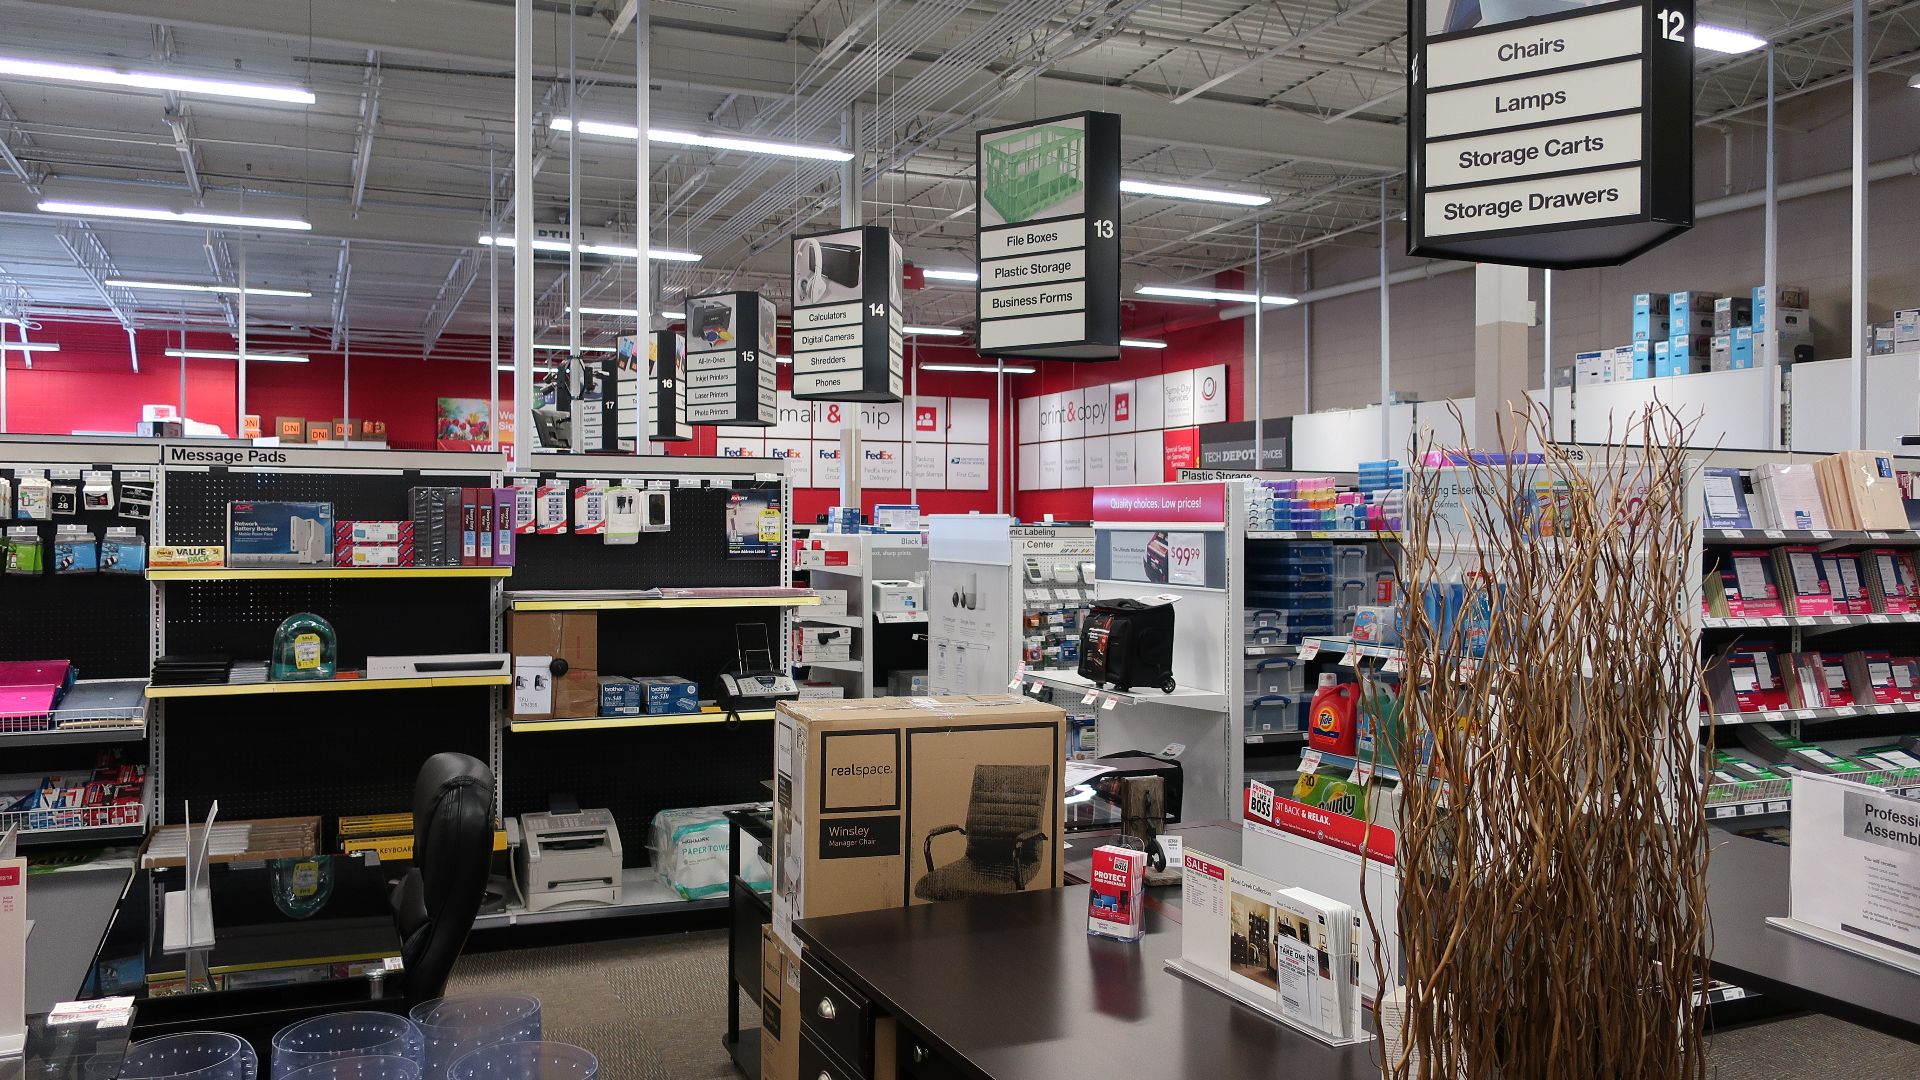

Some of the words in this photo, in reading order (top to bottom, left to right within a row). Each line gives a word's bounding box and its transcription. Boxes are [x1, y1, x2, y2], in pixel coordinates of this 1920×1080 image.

[1657, 8, 1685, 43] 12
[1497, 37, 1565, 62] Chairs
[1495, 89, 1567, 114] Lamps
[1458, 143, 1540, 169] Storage
[1544, 135, 1604, 158] Carts
[1443, 195, 1523, 221] Storage
[1528, 186, 1619, 211] Drawers
[1093, 219, 1114, 239] 13
[1006, 234, 1024, 247] File
[1026, 231, 1058, 245] Boxes
[994, 265, 1029, 279] Plastic
[1030, 260, 1072, 275] Storage
[992, 294, 1038, 309] Business
[1039, 291, 1073, 304] Forms
[868, 302, 885, 317] 14
[808, 310, 847, 322] Calculators
[801, 333, 824, 345] Digital
[824, 332, 855, 343] Cameras
[698, 356, 726, 365] All-in-Ones
[741, 350, 755, 362] 15
[810, 354, 846, 366] Shredders
[661, 378, 673, 389] 16
[695, 373, 709, 383] Inkjet
[709, 373, 729, 381] Printers
[815, 377, 841, 387] Phones
[694, 391, 709, 400] Laser
[709, 391, 729, 400] Printers
[605, 400, 615, 410] 17
[694, 409, 709, 417] Photo
[709, 408, 729, 416] Printers
[780, 402, 822, 423] mail
[827, 404, 840, 423] &
[1040, 405, 1066, 431] print
[1066, 401, 1076, 422] &
[1077, 401, 1108, 425] copy
[284, 424, 299, 432] DNI
[498, 421, 514, 432] Sig
[312, 431, 328, 439] DNI
[171, 449, 244, 465] Message
[248, 449, 287, 464] Pads
[724, 447, 753, 457] FedEx
[772, 448, 800, 459] FedEx
[820, 449, 840, 460] FedE
[865, 450, 892, 460] FedEx
[1205, 451, 1221, 462] TECH
[1222, 449, 1256, 461] DEPOT
[1262, 449, 1283, 460] RVICES
[1182, 471, 1214, 481] Plastic
[1215, 471, 1252, 480] Storage
[1110, 498, 1133, 511] Quality
[1133, 497, 1160, 509] choices.
[1161, 497, 1176, 508] Low
[1177, 497, 1202, 512] prices!
[1024, 528, 1056, 538] Labeling
[901, 537, 919, 545] Black
[1026, 540, 1054, 549] Center
[176, 548, 206, 556] VALUE
[187, 554, 209, 564] PACK
[1319, 712, 1333, 727] Tide
[1252, 783, 1273, 796] PROTECT
[1256, 793, 1268, 802] LIKE
[1250, 797, 1271, 817] BOSS
[1275, 801, 1283, 811] SIT
[1284, 804, 1301, 816] BACK
[1301, 809, 1307, 819] &
[1307, 811, 1331, 826] RELAX.
[1864, 803, 1920, 828] Professi
[828, 825, 870, 837] Winsley
[1863, 821, 1920, 847] Assembl
[828, 839, 857, 848] Manager
[858, 837, 876, 846] Chair
[379, 846, 413, 855] KEYBOAR
[682, 846, 707, 856] PAPER
[1186, 857, 1209, 874] SALE
[1093, 870, 1127, 883] PROTECT
[1279, 945, 1294, 957] TAKE
[1294, 952, 1306, 963] ONE
